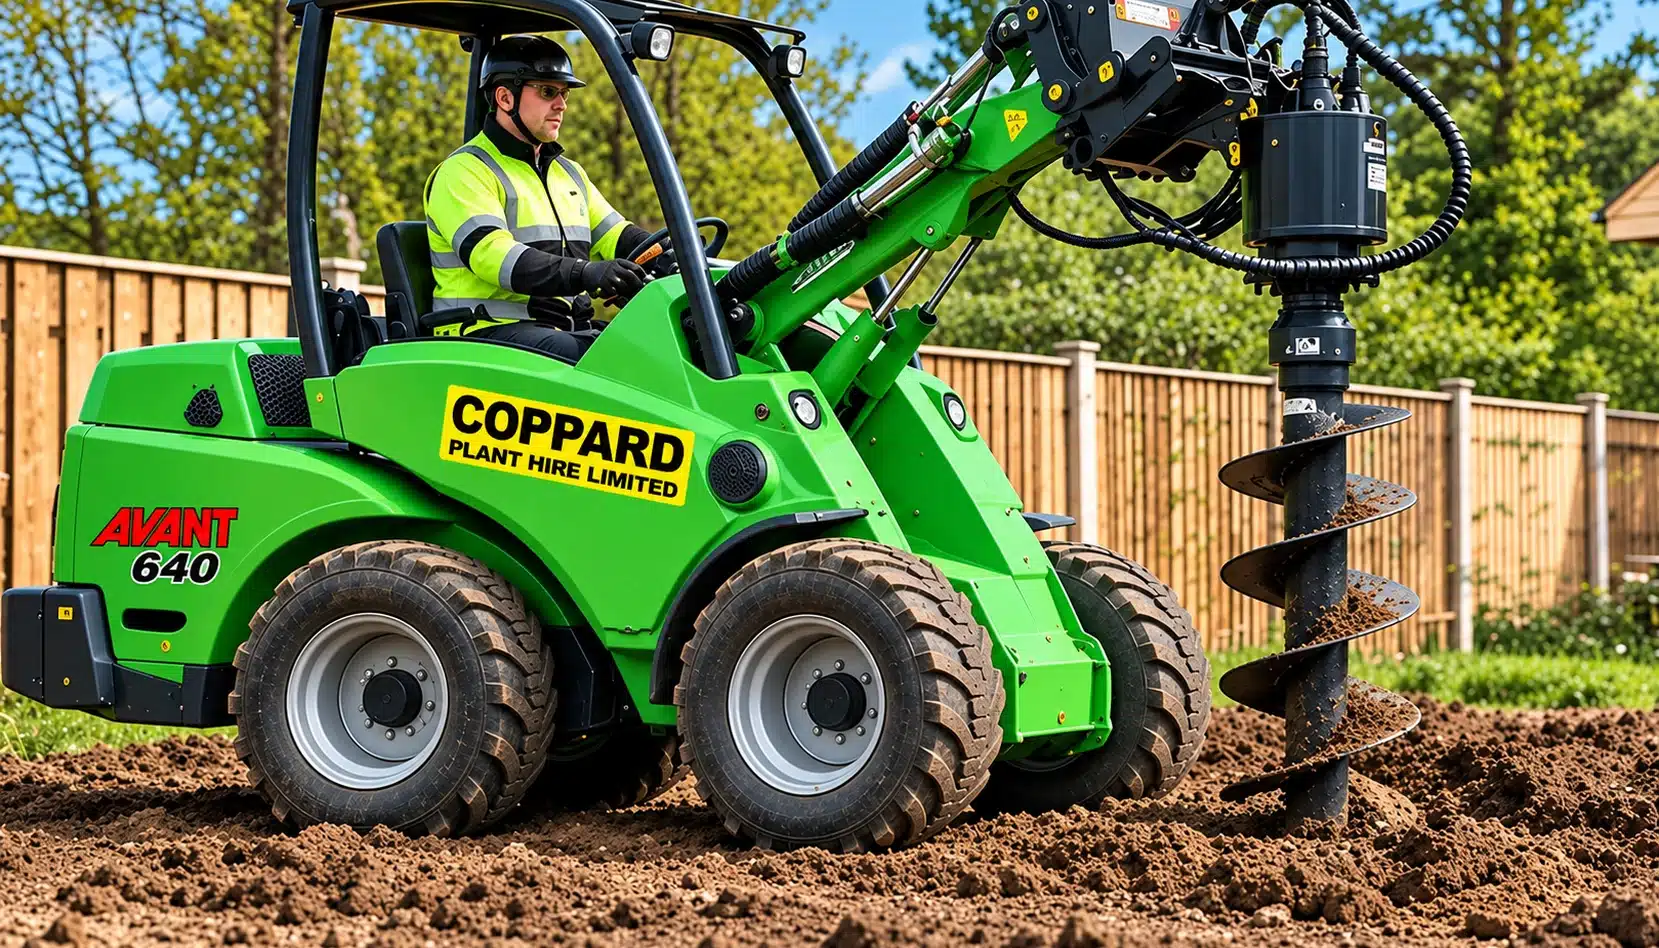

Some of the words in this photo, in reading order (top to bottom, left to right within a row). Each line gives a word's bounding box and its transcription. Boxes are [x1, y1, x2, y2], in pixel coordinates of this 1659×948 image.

[452, 394, 685, 473] COPPARD
[448, 439, 523, 468] PLANT
[528, 455, 581, 480] HIRE
[587, 466, 678, 498] LIMITED
[90, 507, 239, 548] AVANT
[131, 550, 220, 585] 640
